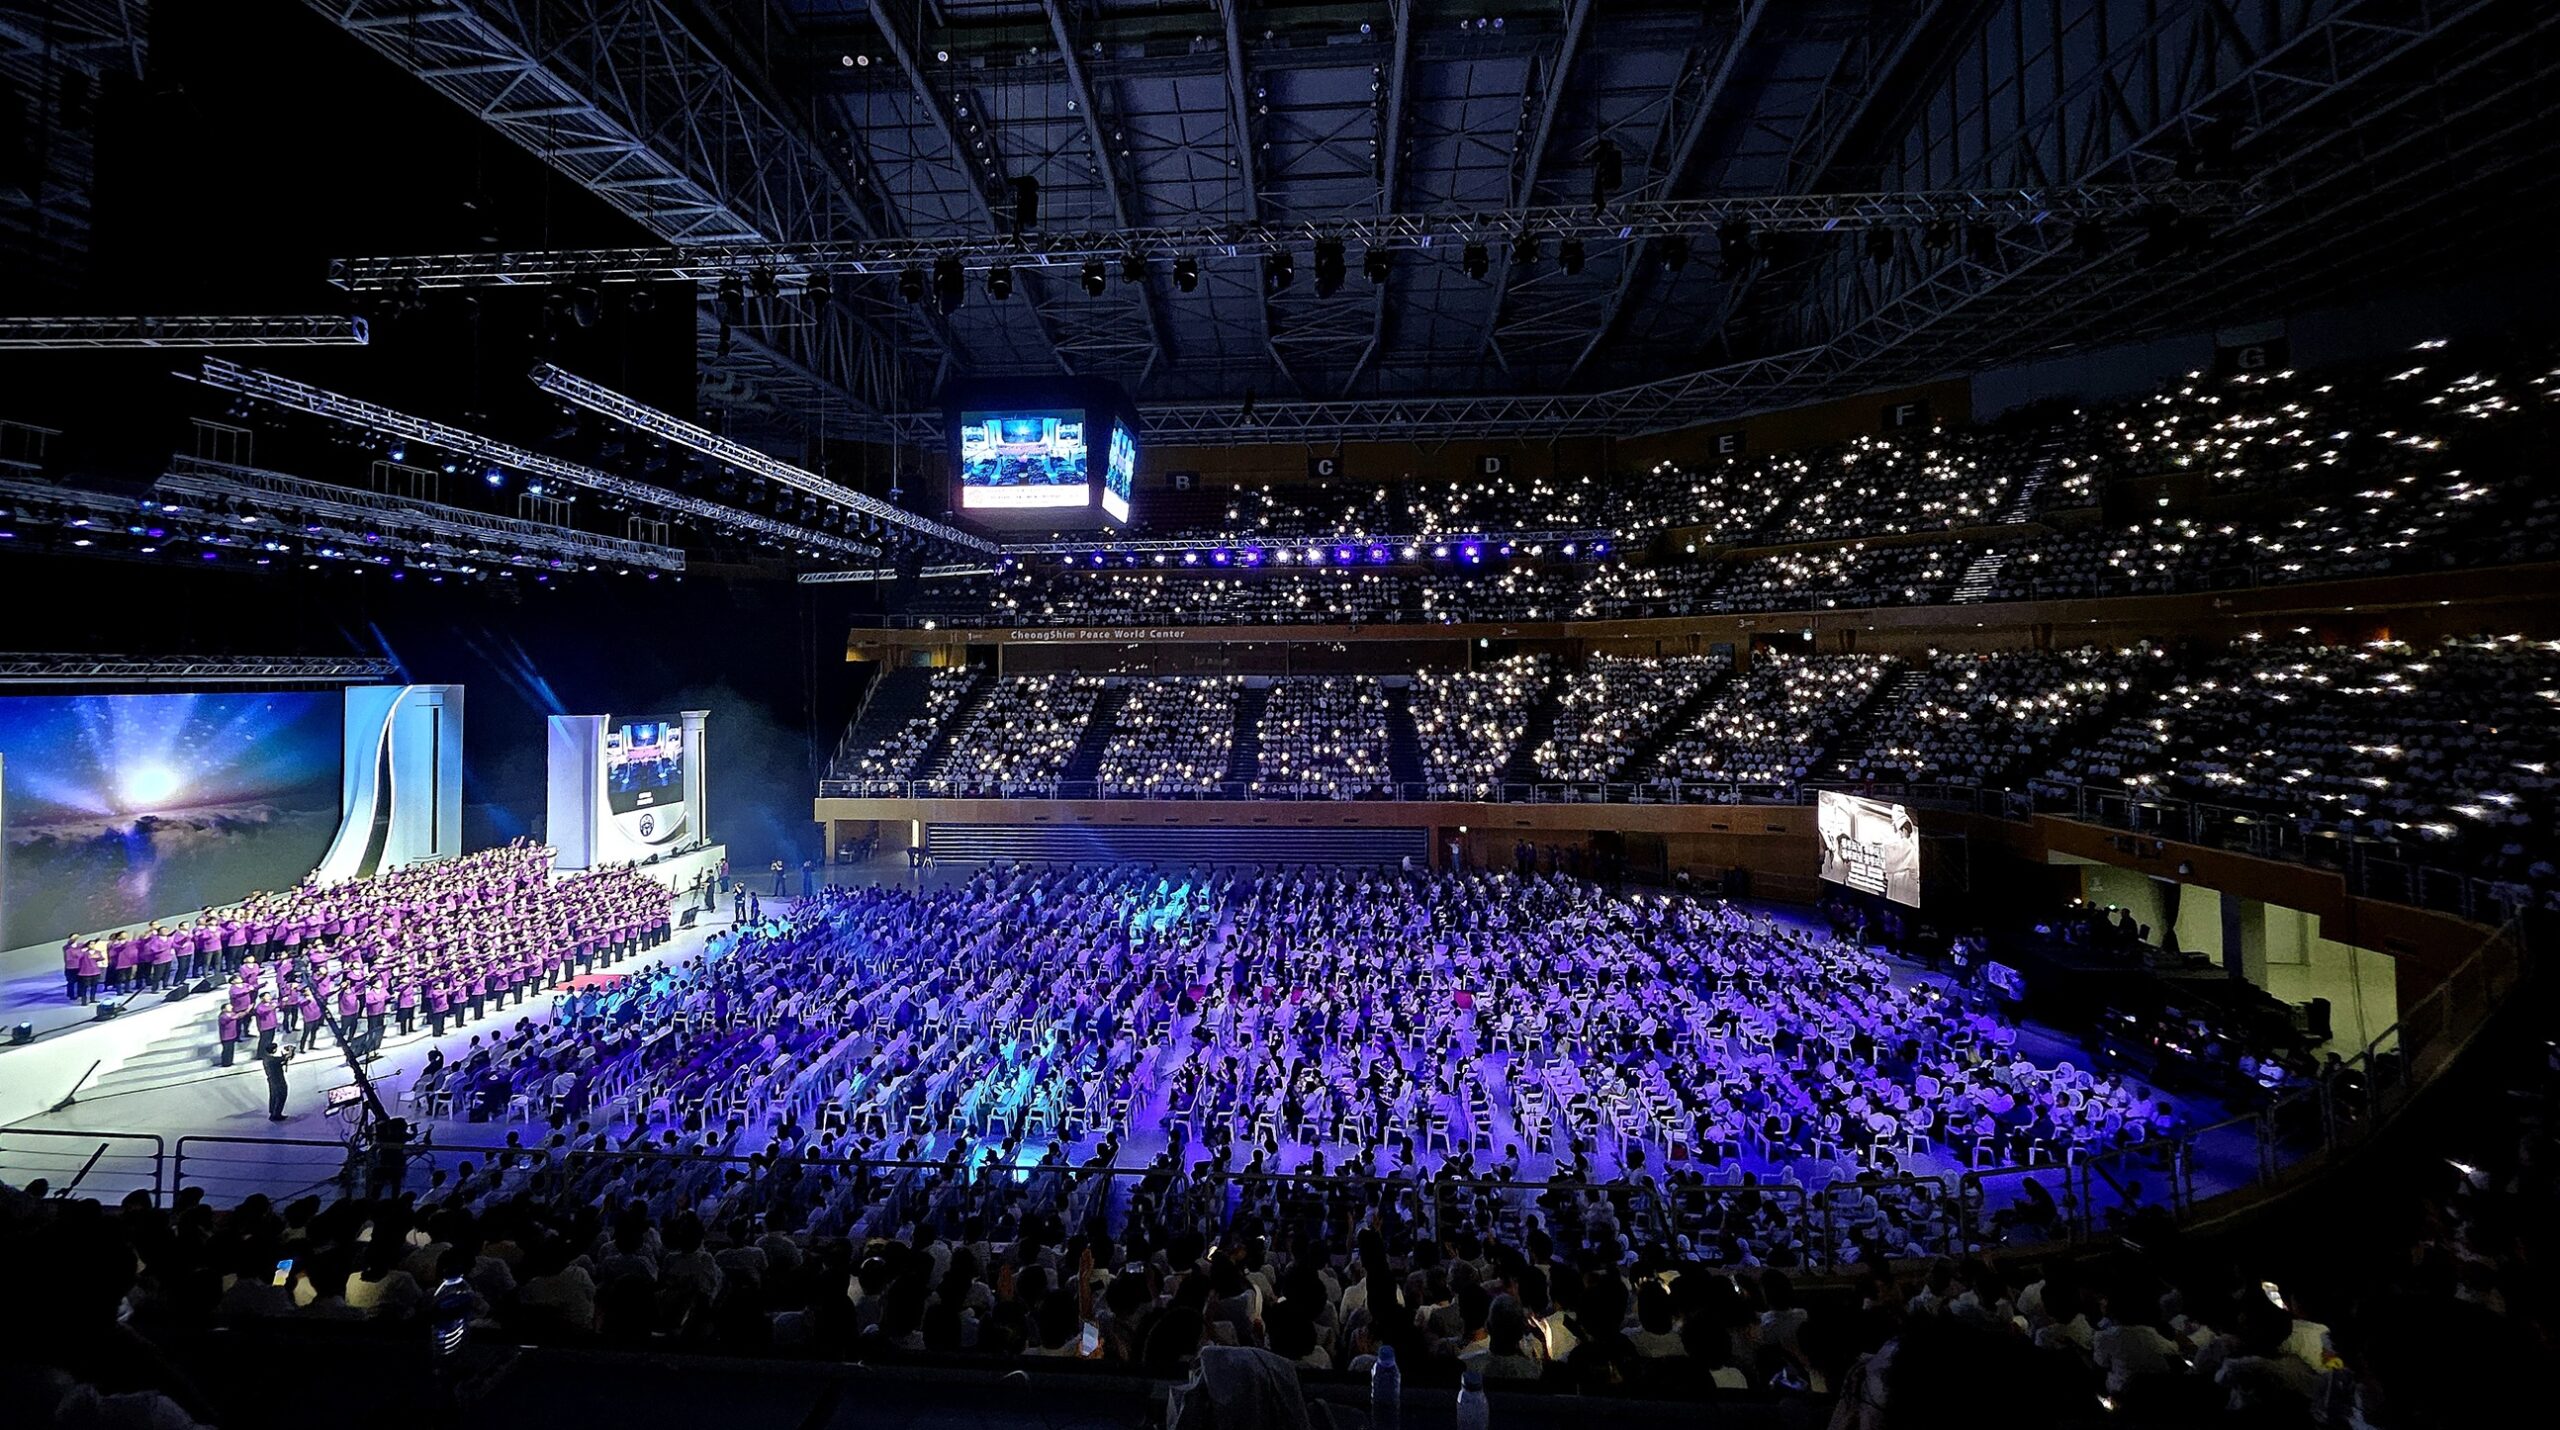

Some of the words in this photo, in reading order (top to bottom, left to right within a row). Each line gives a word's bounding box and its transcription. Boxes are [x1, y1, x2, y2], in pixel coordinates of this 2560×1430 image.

[2238, 347, 2265, 369] G
[1896, 404, 1916, 426] F
[1719, 434, 1735, 454] E
[1318, 459, 1334, 476] C
[1485, 457, 1501, 474] D
[1175, 475, 1190, 491] B
[1010, 630, 1076, 641] CheongShim
[1079, 630, 1110, 640] Peace
[1114, 629, 1145, 639] World
[1149, 629, 1185, 639] Center
